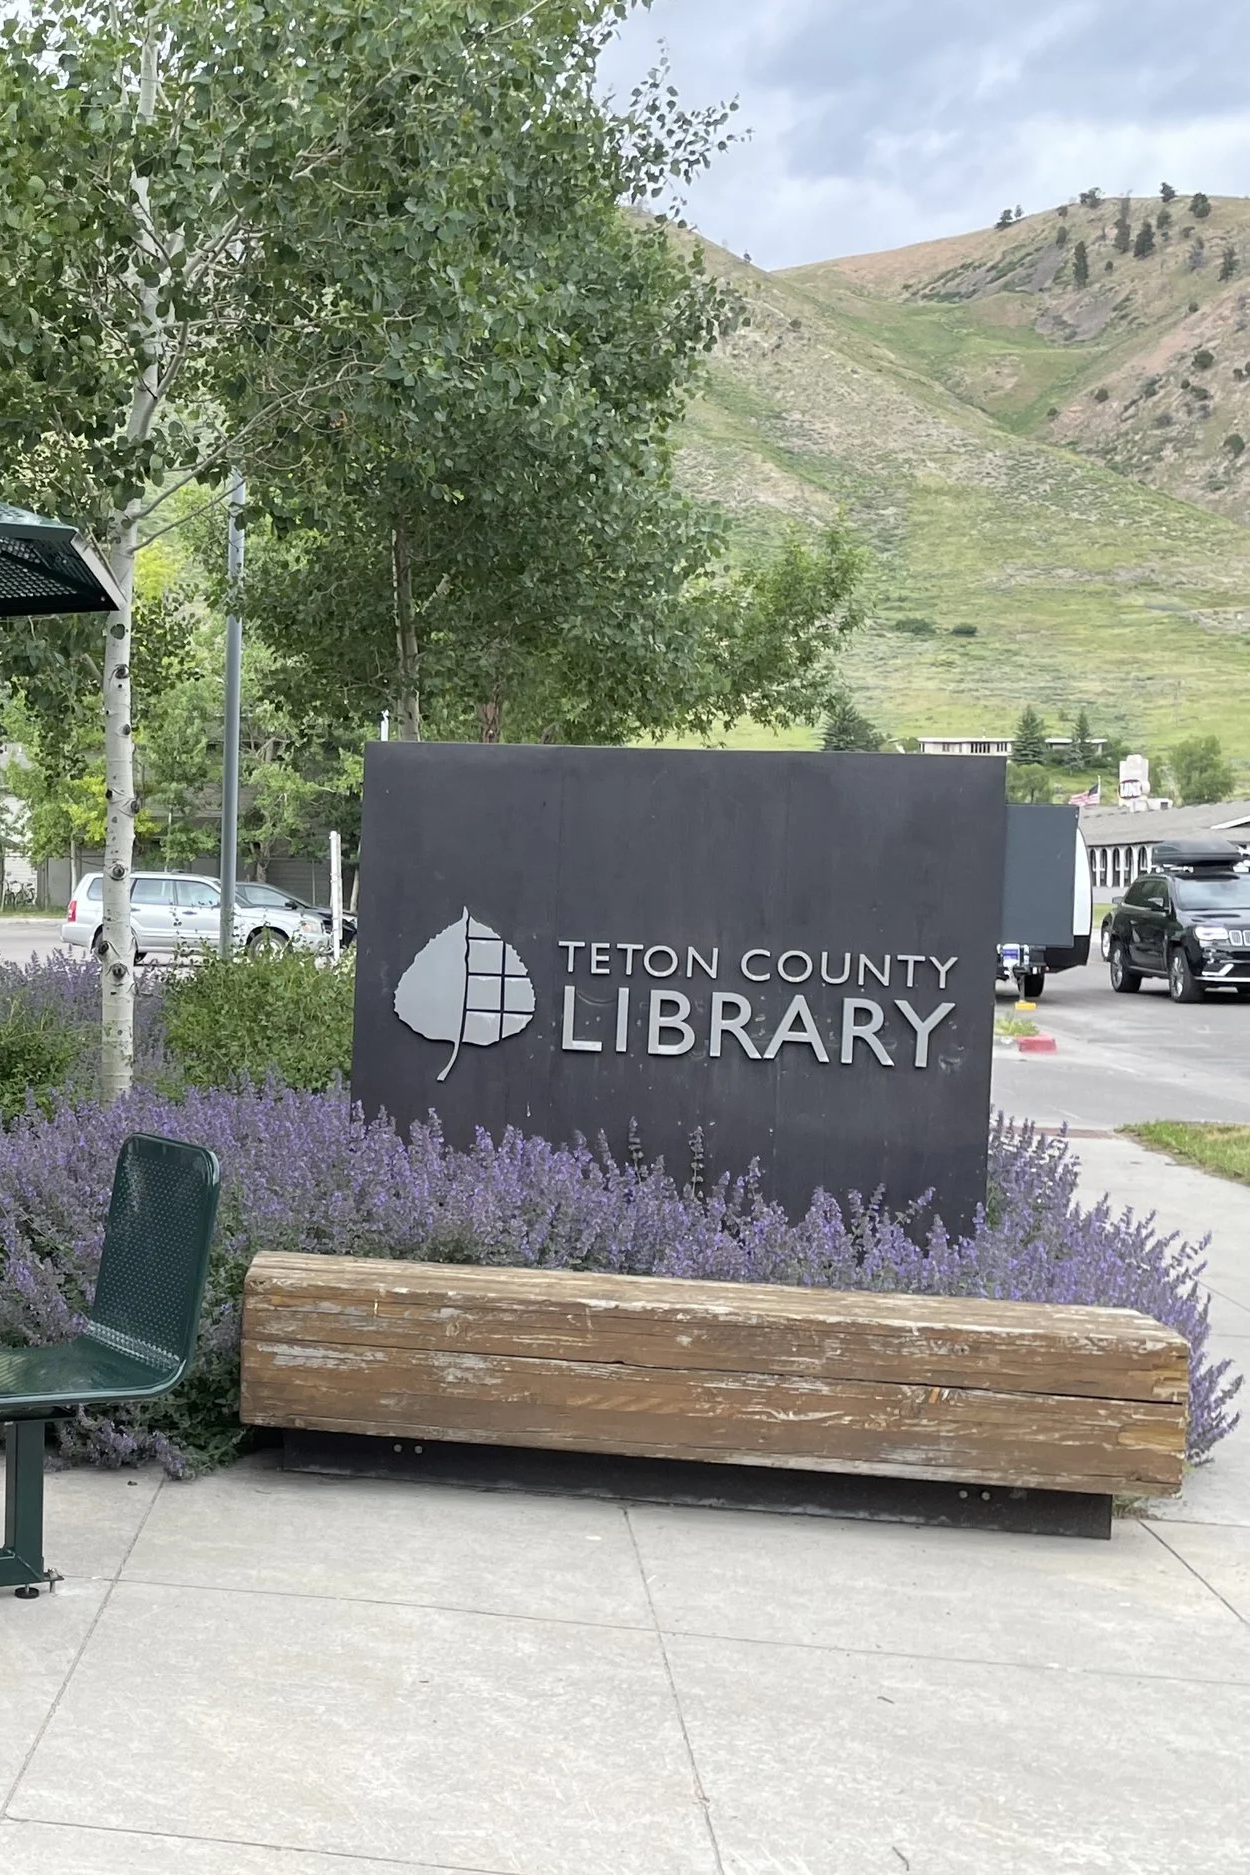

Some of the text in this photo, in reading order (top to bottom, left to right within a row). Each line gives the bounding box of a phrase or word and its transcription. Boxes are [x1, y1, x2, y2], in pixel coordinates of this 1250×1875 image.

[558, 940, 958, 988] TETON COUNTY
[562, 985, 956, 1067] LIBRARY
